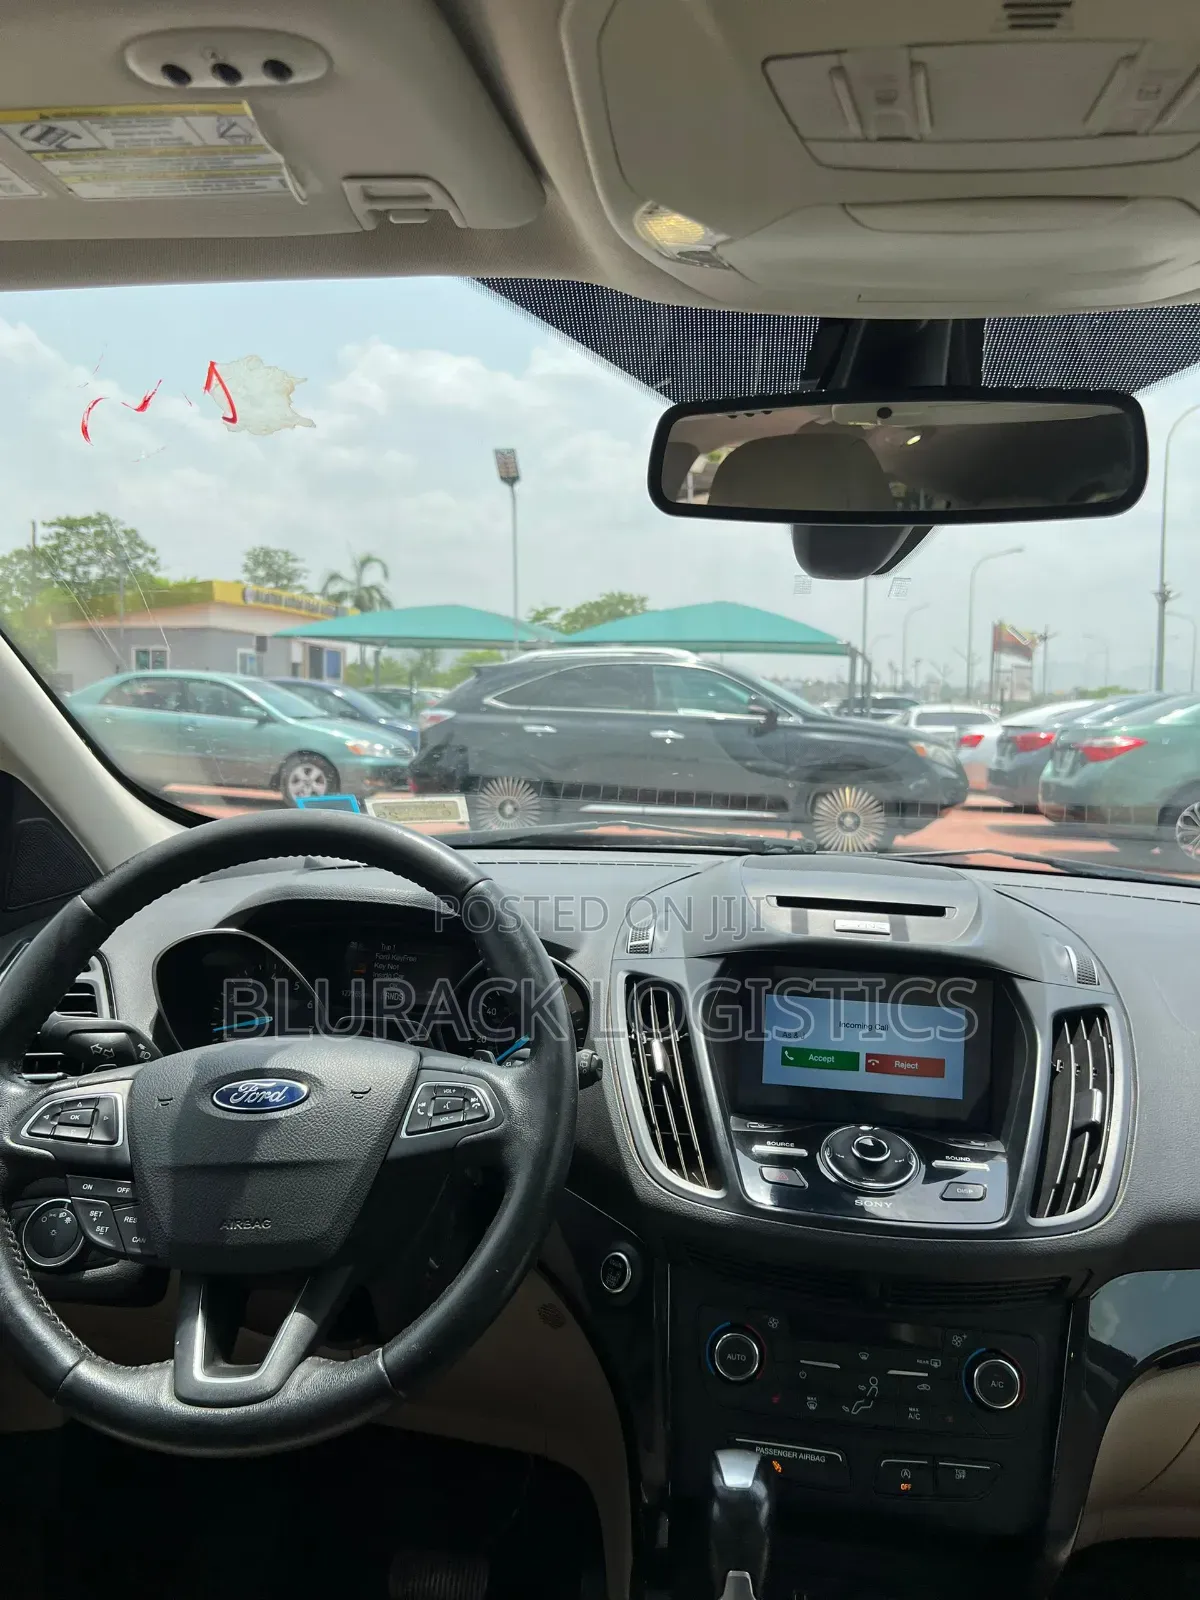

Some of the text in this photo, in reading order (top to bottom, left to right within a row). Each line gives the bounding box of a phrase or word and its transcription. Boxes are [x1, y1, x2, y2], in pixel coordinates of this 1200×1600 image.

[373, 962, 400, 971] Key Not
[292, 981, 300, 991] 5
[306, 1000, 313, 1009] 6
[486, 1007, 497, 1015] 40
[838, 1020, 889, 1031] Incoming Call
[476, 1035, 487, 1044] 20
[808, 1053, 835, 1063] Accept
[894, 1060, 919, 1070] Reject
[229, 1081, 289, 1104] Ford
[766, 1140, 795, 1148] SOURCE
[116, 1186, 130, 1194] OFF
[854, 1199, 893, 1208] SONY
[123, 1215, 138, 1224] RES
[219, 1218, 272, 1230] AIRBAG
[726, 1353, 747, 1362] AUTO
[990, 1380, 1004, 1389] A/C
[907, 1412, 921, 1421] A/C
[755, 1446, 826, 1463] PASSENGER AIRBAG
[900, 1483, 912, 1491] OFF
